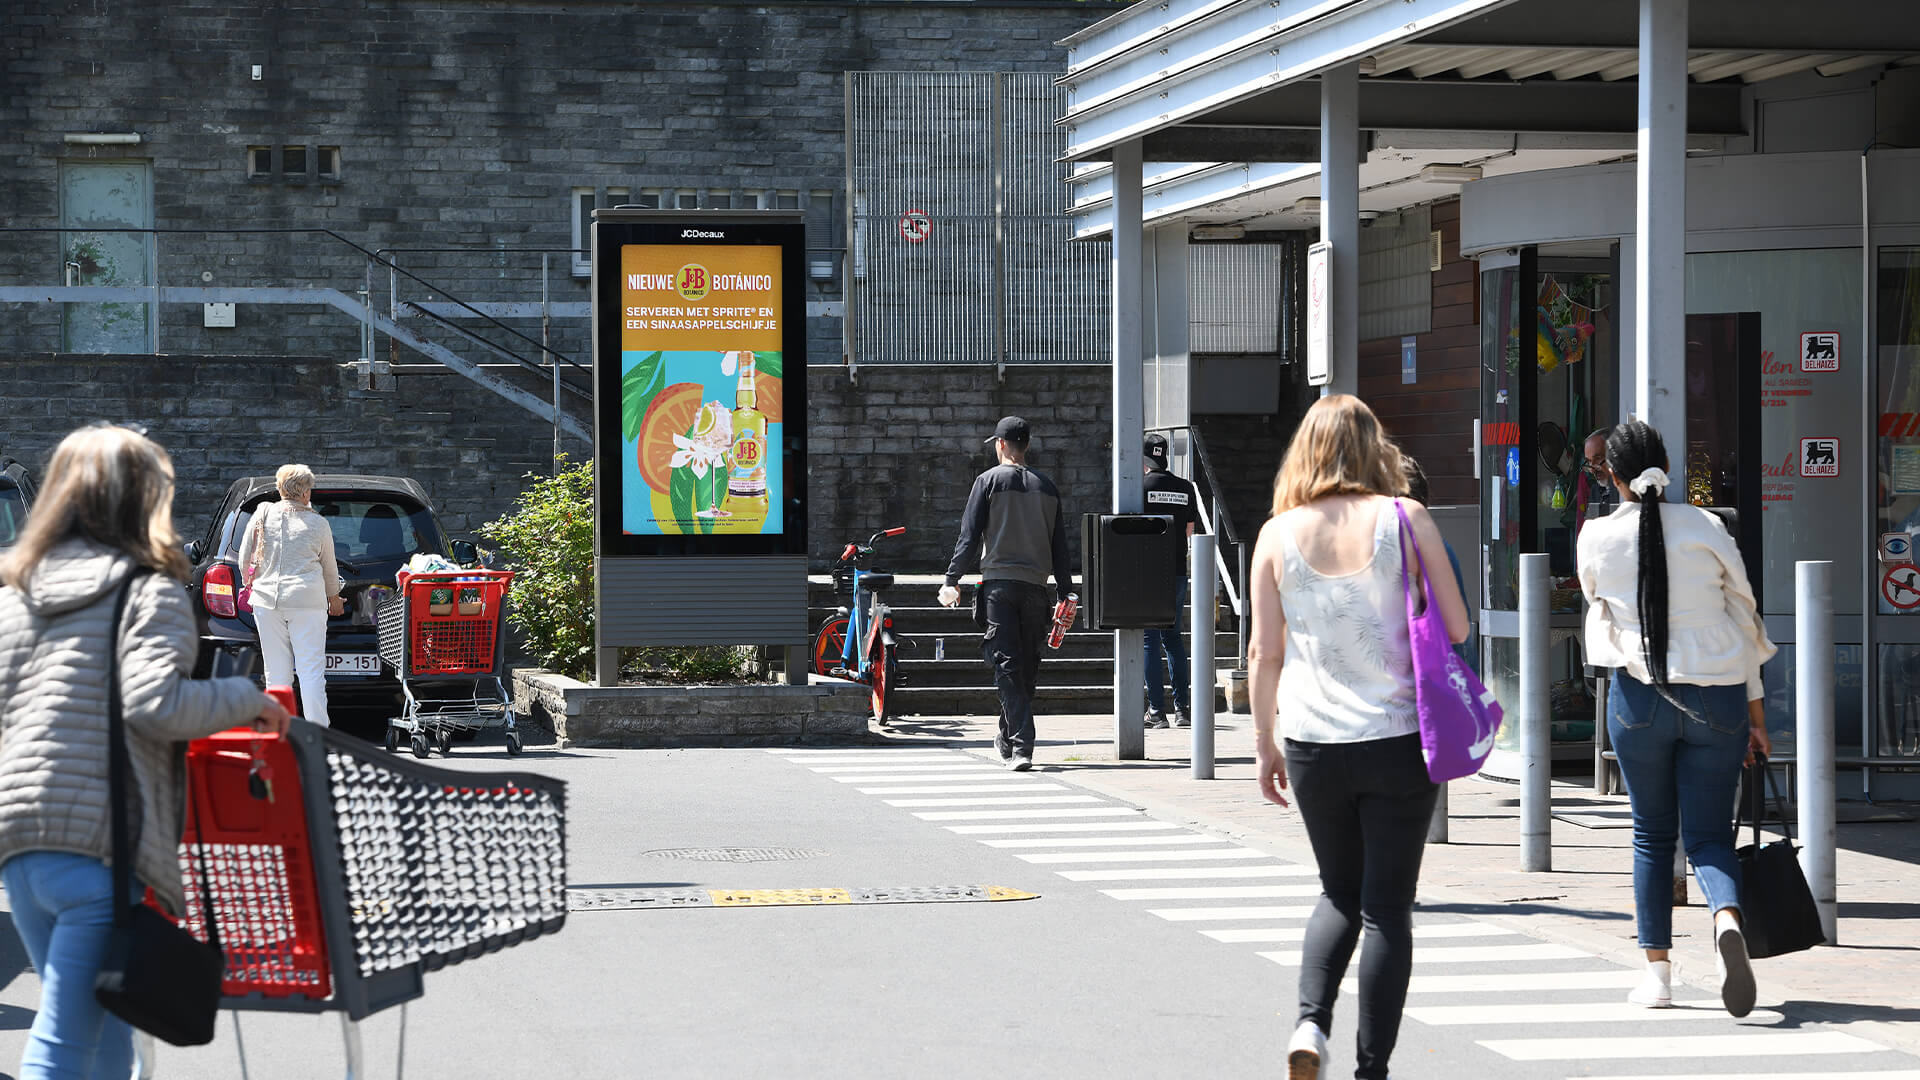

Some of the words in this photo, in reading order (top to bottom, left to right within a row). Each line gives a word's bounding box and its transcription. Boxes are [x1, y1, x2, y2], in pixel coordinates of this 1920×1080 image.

[681, 229, 725, 239] JCDecaux
[627, 274, 674, 291] NIEUWE
[681, 267, 705, 289] J&B
[712, 271, 772, 291] BOTÁNICO
[626, 307, 684, 317] SERVEREN
[686, 307, 710, 317] MET
[758, 307, 774, 317] EN
[626, 320, 648, 330] EEN
[650, 320, 777, 330] SINAASAPPELSCHIJFJE
[1805, 360, 1836, 369] DELHAIZE
[736, 441, 757, 460] J&B
[1761, 452, 1795, 477] euk
[1804, 465, 1836, 474] DELHAIZE
